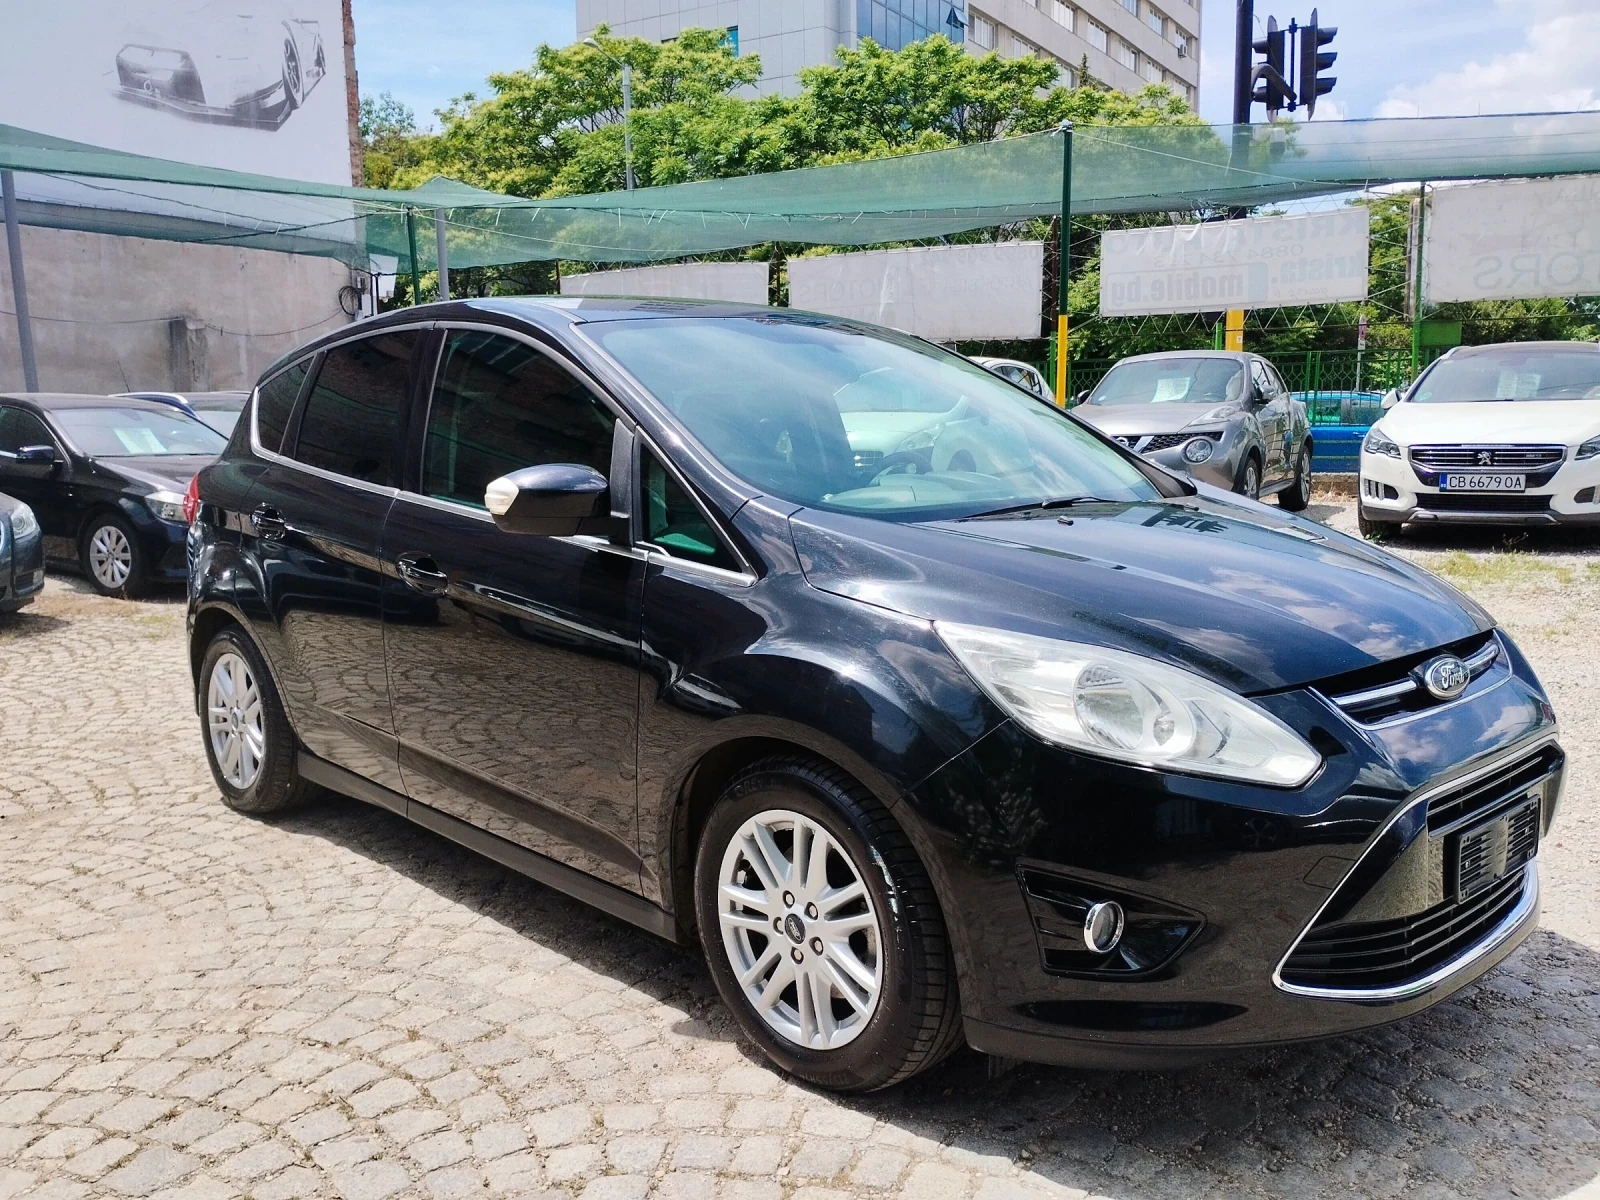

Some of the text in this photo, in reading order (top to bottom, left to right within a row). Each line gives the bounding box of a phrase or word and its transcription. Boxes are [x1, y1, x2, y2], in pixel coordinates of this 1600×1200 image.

[1449, 476, 1466, 488] CB
[1469, 476, 1502, 488] 6679
[1440, 663, 1468, 689] Ford
